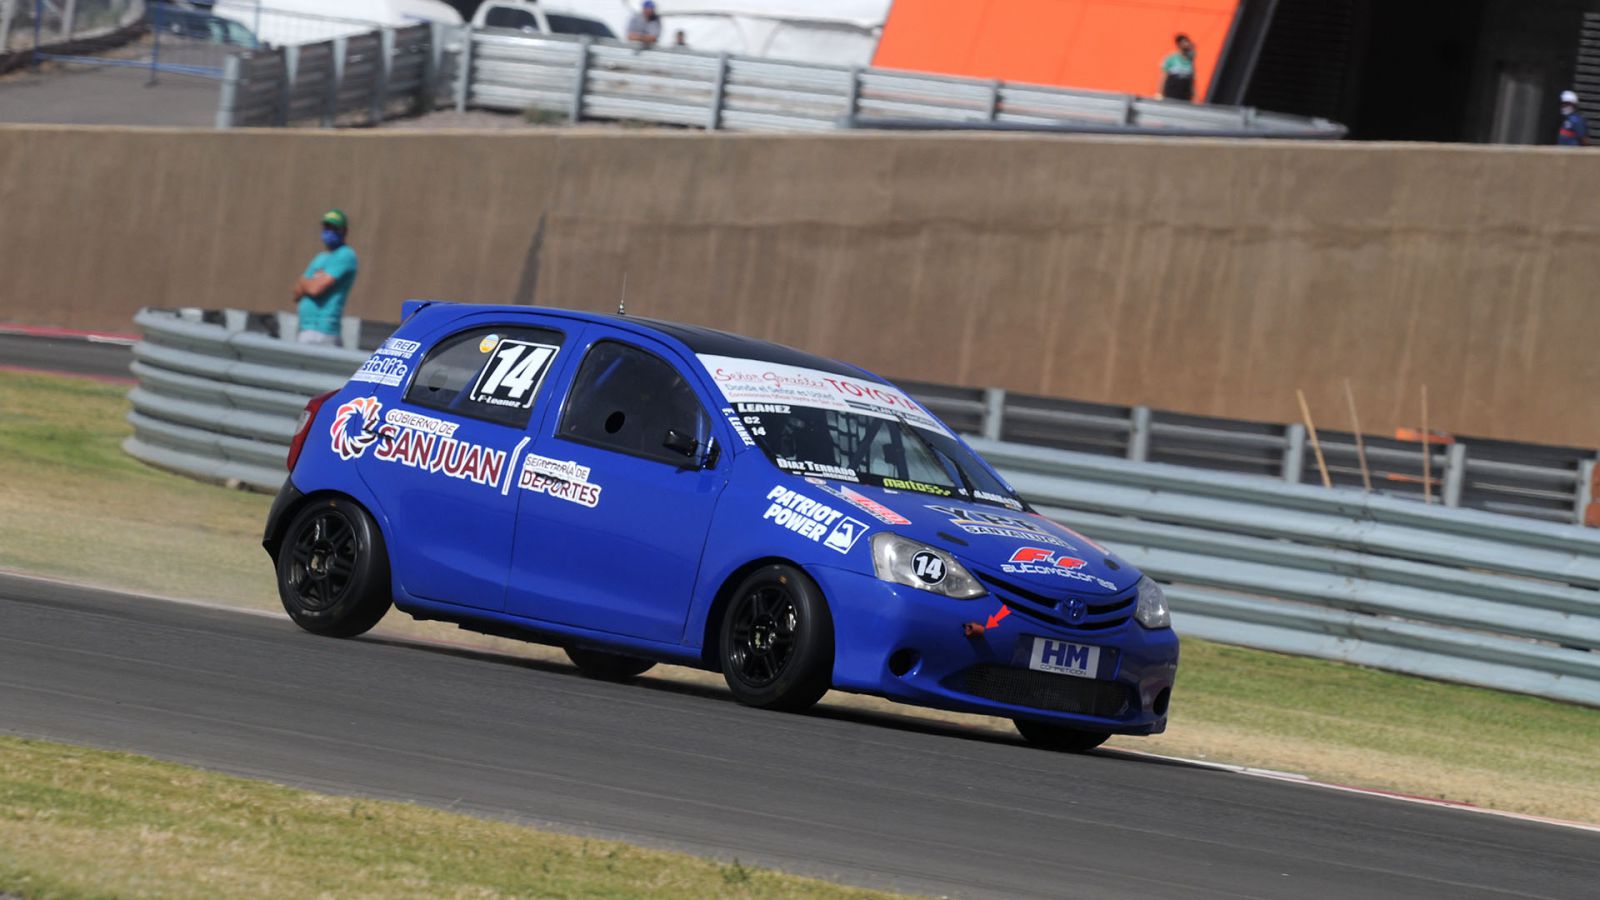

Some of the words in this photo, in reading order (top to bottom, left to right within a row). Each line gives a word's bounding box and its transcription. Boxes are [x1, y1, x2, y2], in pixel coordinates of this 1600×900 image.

[481, 345, 553, 398] 14
[738, 403, 791, 414] LEANEZ
[824, 378, 926, 414] TOYOTA
[387, 410, 439, 431] GOBIERNO
[439, 423, 456, 435] DE
[728, 417, 755, 446] LEANEZ
[744, 416, 760, 425] C2
[751, 426, 766, 436] 14
[376, 425, 435, 467] SAN
[432, 440, 504, 484] JUAN
[521, 470, 598, 505] DEPORTES
[575, 468, 588, 479] DE
[883, 478, 935, 493] martos
[766, 485, 844, 526] PATRIOT
[763, 503, 828, 543] POWER
[916, 555, 942, 579] 14
[1000, 563, 1118, 591] automotores
[1041, 640, 1089, 670] HM
